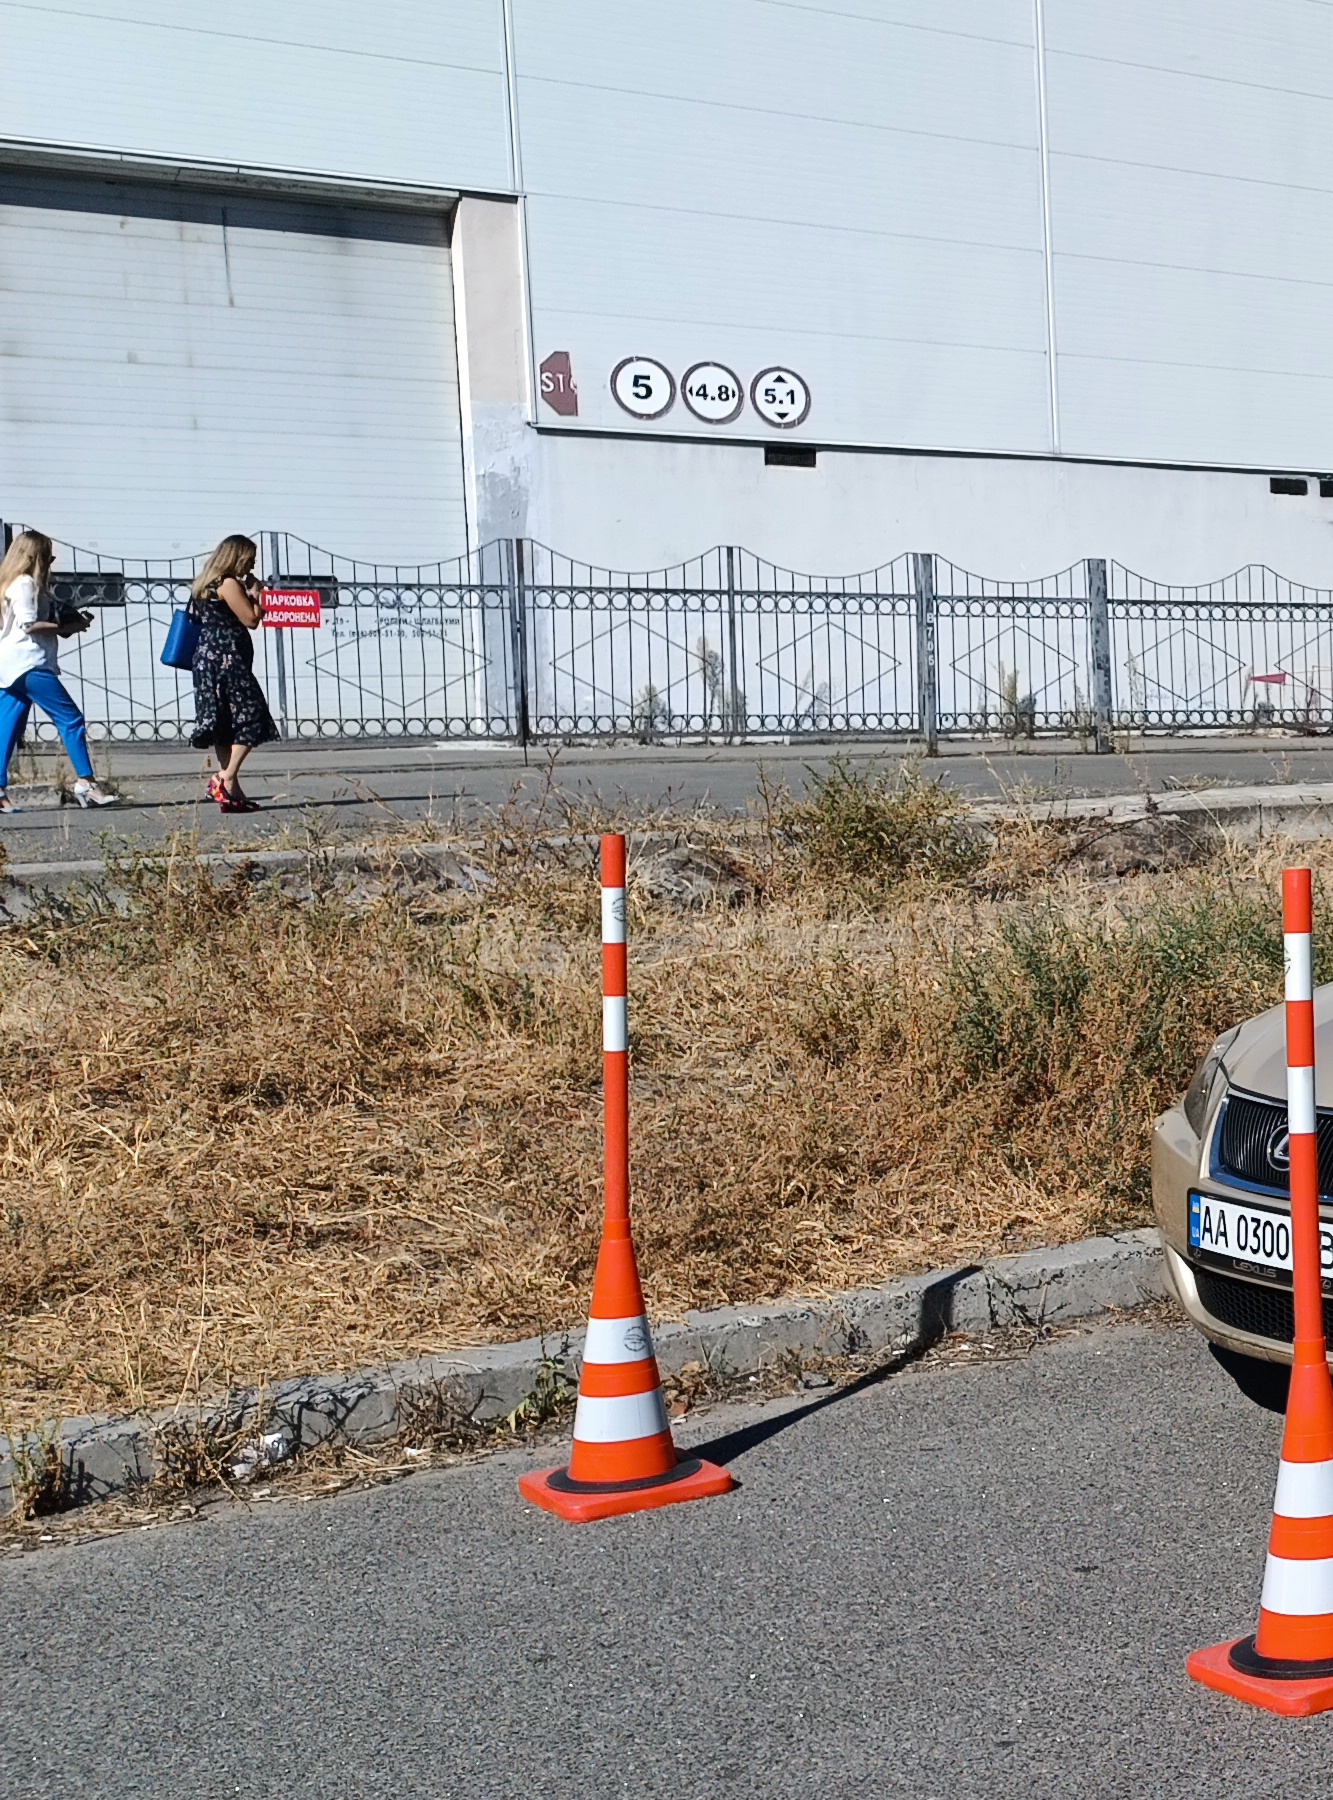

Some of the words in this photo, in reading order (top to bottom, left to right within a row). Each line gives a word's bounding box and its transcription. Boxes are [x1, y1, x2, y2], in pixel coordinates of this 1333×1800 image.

[632, 374, 653, 400] 5
[695, 383, 730, 402] 4.8
[764, 388, 796, 405] 5.1
[265, 593, 315, 606] ПАРКОВКА
[1201, 1205, 1229, 1248] AA
[1236, 1214, 1290, 1261] 0300
[1232, 1259, 1278, 1278] LEXUS
